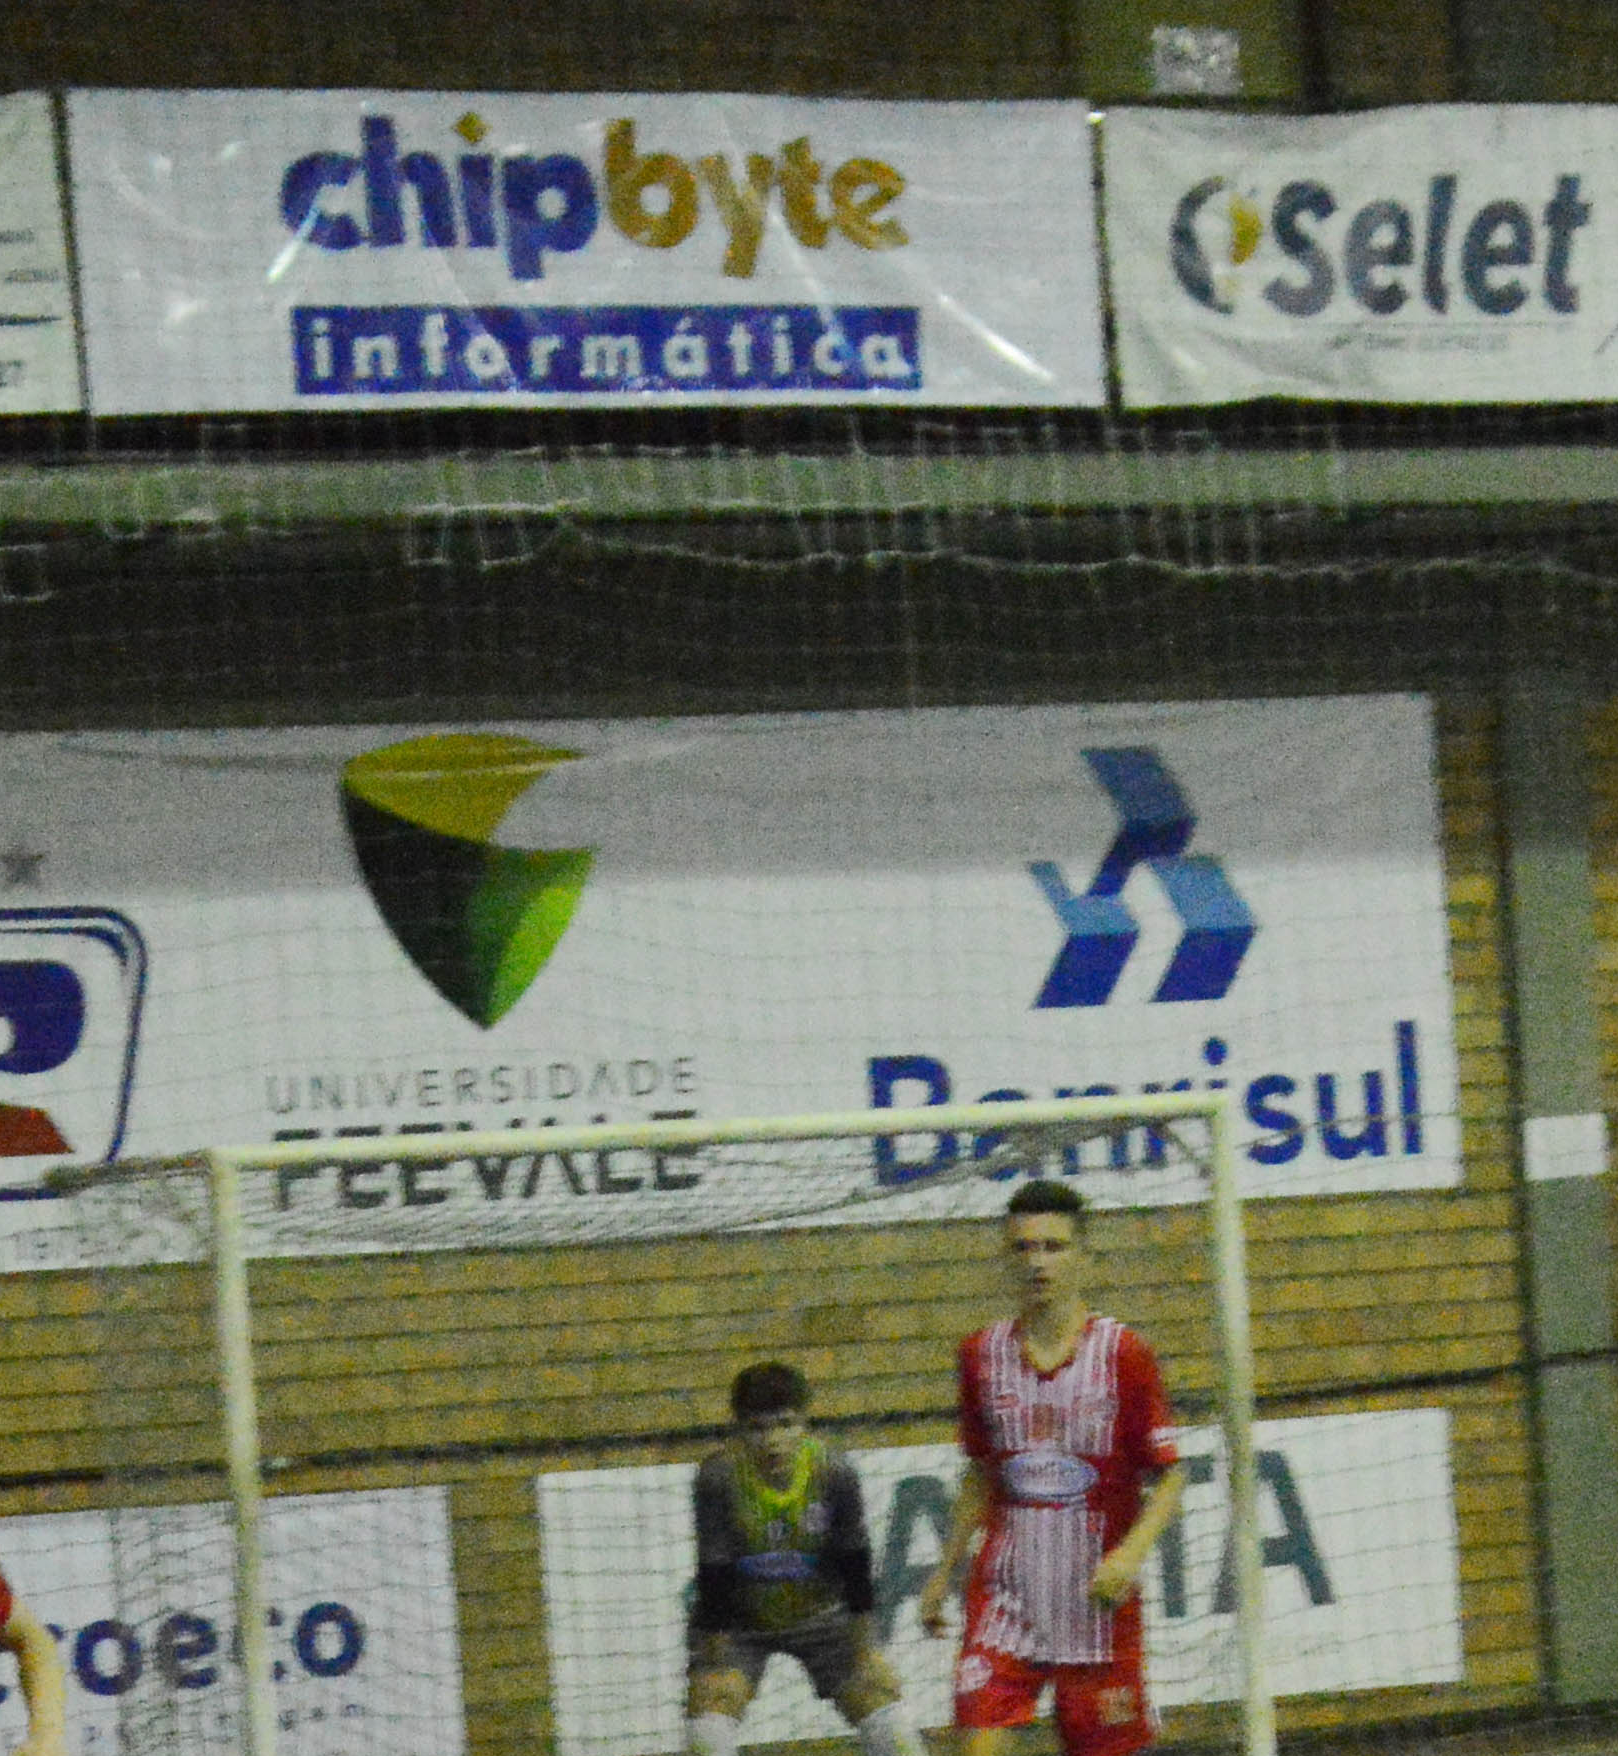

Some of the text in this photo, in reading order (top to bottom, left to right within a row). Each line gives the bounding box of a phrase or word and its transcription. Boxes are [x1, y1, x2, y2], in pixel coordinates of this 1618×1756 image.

[278, 112, 909, 281] chipbyte
[1263, 172, 1592, 318] Selet
[309, 312, 913, 382] informática
[265, 1055, 699, 1115] UNIVERSIDADE
